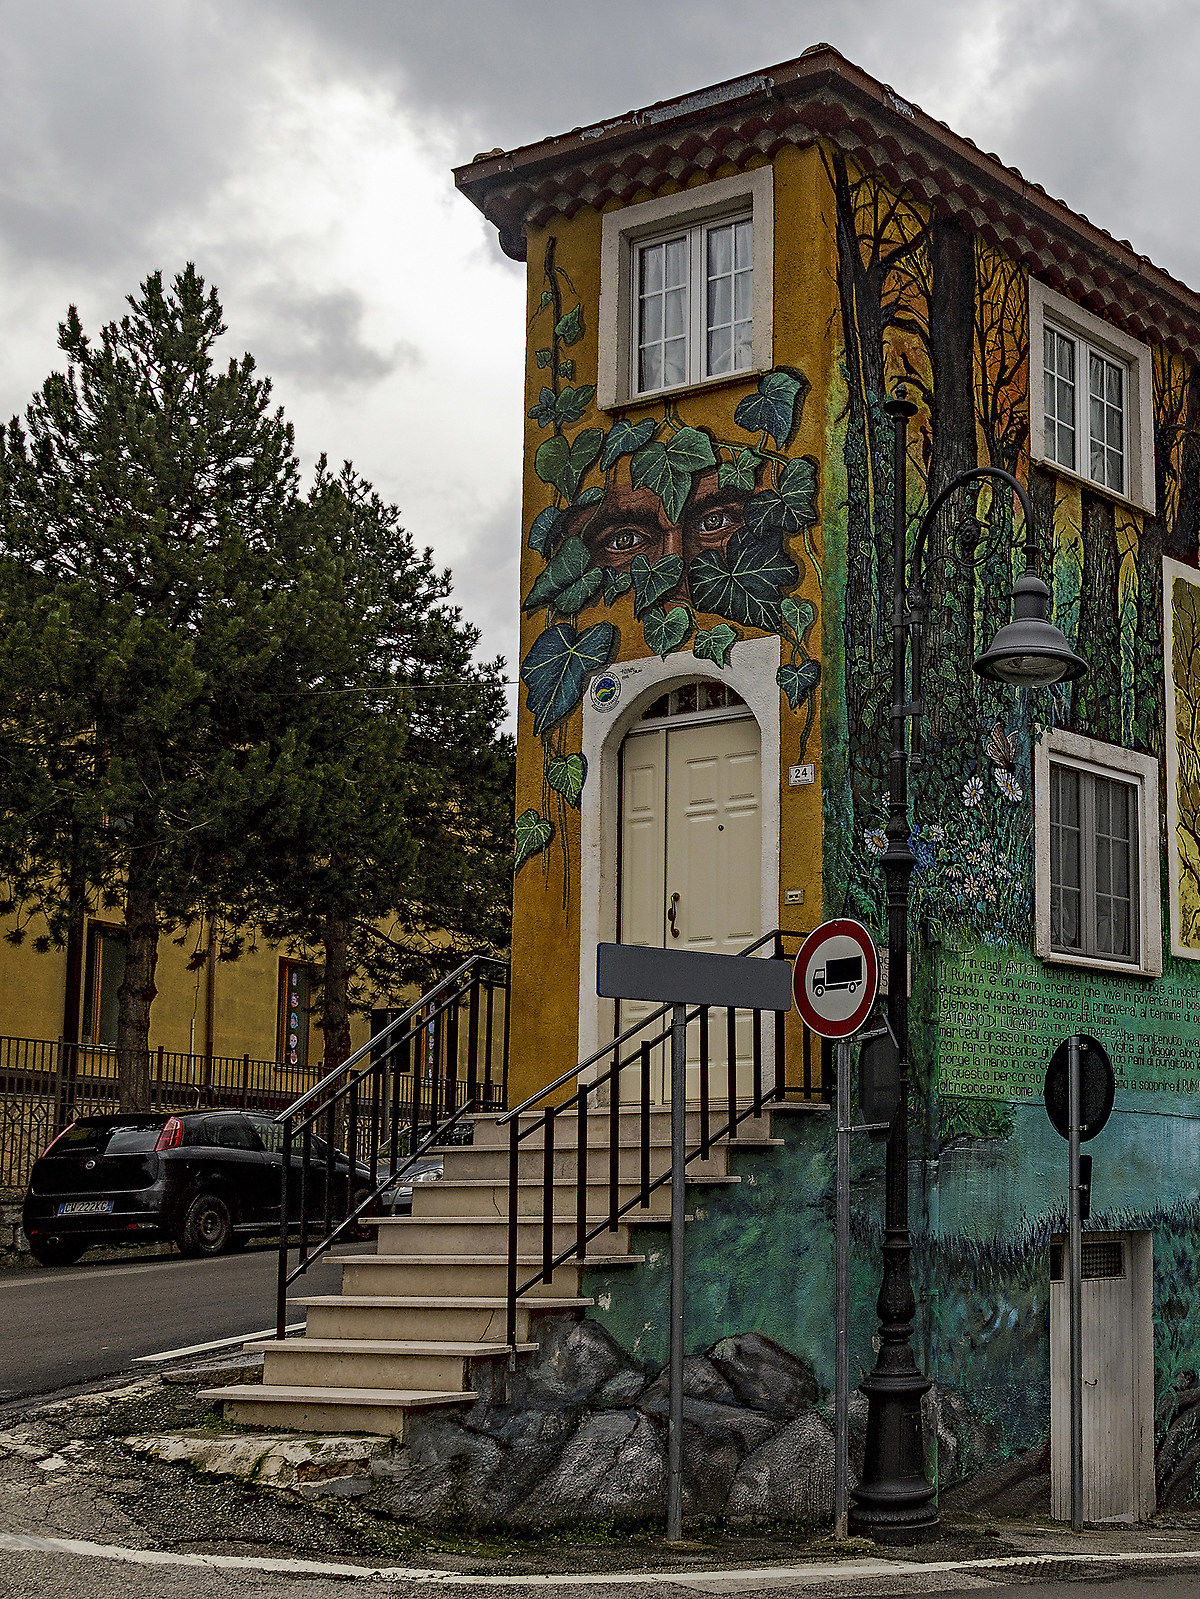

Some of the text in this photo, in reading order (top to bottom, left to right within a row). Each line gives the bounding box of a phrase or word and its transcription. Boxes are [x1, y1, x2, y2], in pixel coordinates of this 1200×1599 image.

[795, 768, 807, 778] 24
[1001, 977, 1013, 988] un
[1018, 980, 1041, 991] uomo
[1045, 983, 1080, 996] eremita
[1084, 985, 1100, 998] che
[1104, 988, 1120, 1000] vive
[1124, 989, 1131, 1002] in
[1172, 997, 1183, 1009] nel
[939, 1010, 984, 1028] SATRIANO
[986, 1014, 997, 1028] DI
[1140, 1006, 1147, 1019] al
[1184, 1012, 1190, 1023] di
[982, 1031, 1019, 1042] grasso
[939, 1041, 959, 1051] con
[962, 1041, 985, 1053] fare
[988, 1042, 1037, 1056] insistente
[939, 1054, 970, 1067] porge
[972, 1053, 980, 1065] la
[984, 1059, 1008, 1068] mano
[1012, 1059, 1019, 1069] in
[952, 1068, 989, 1080] questo
[993, 1071, 1041, 1084] percorso
[1010, 1086, 1033, 1097] come
